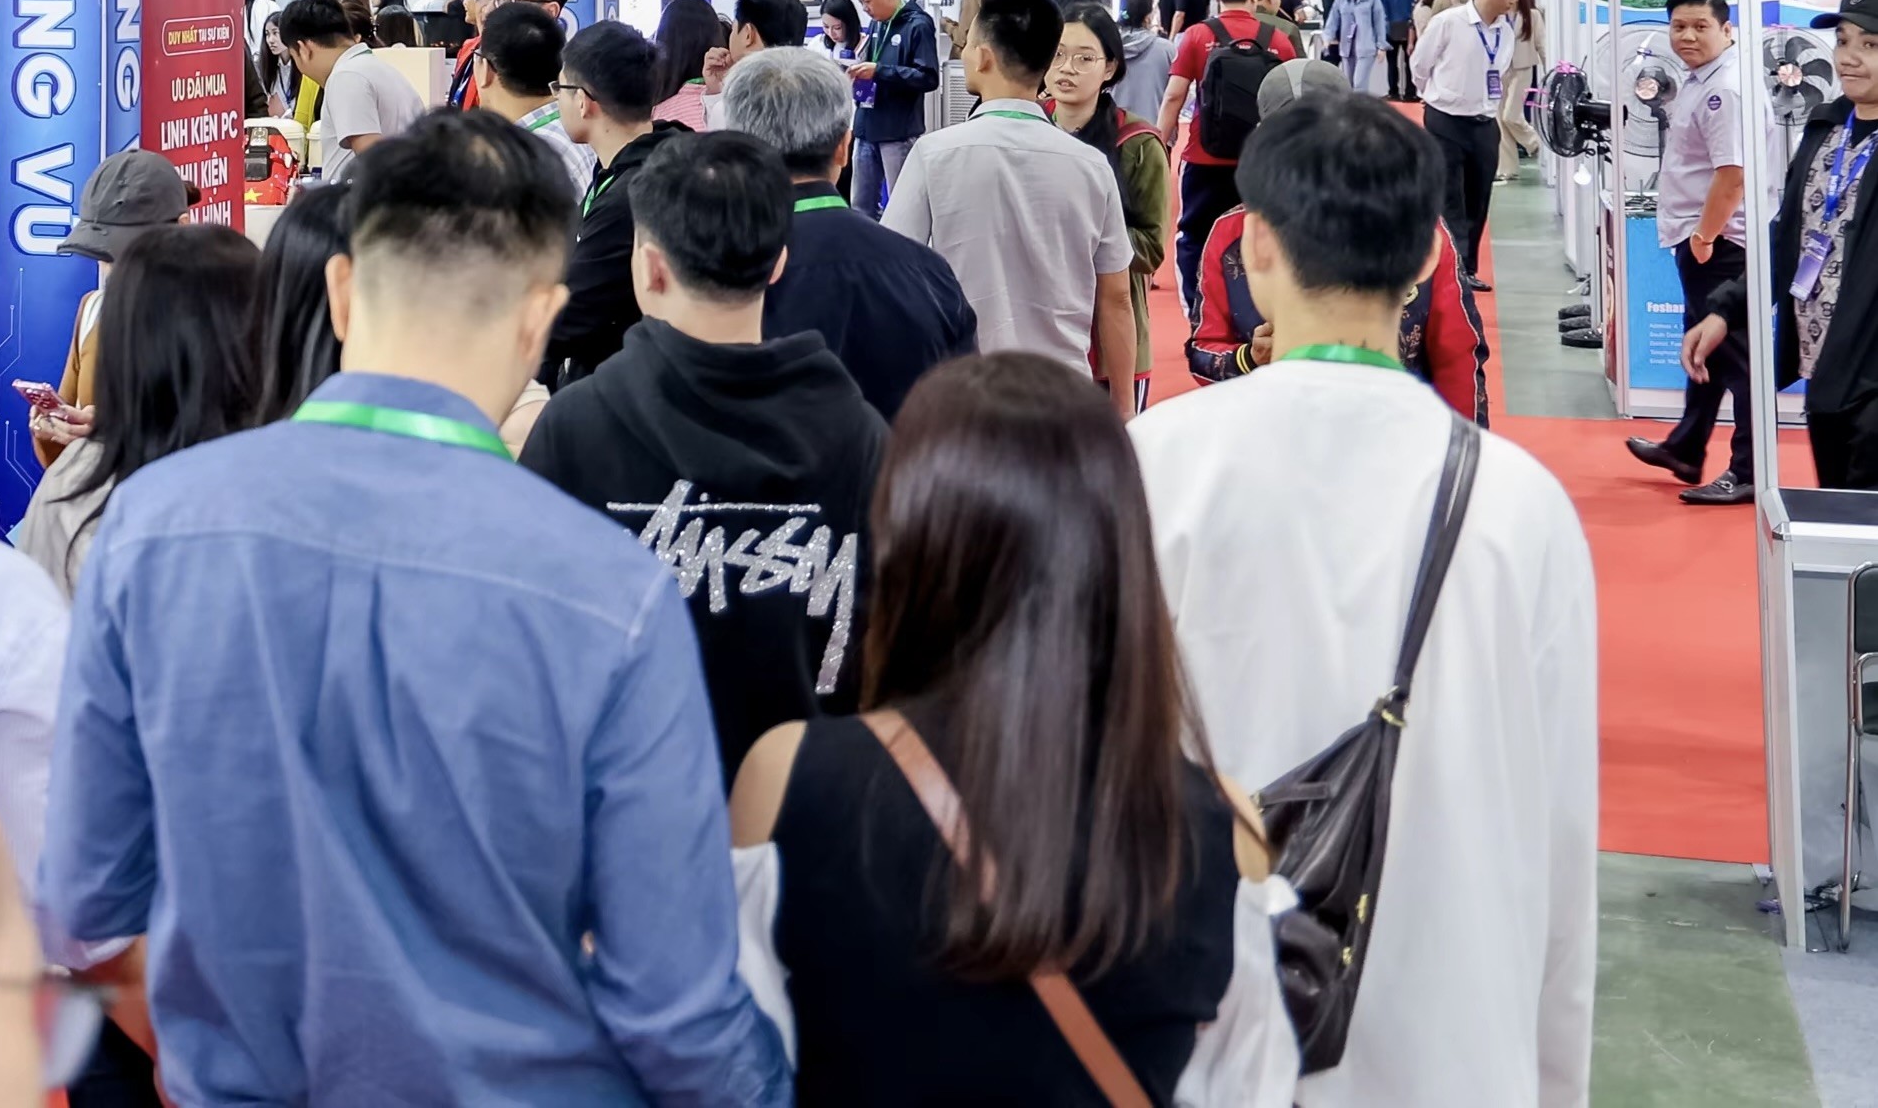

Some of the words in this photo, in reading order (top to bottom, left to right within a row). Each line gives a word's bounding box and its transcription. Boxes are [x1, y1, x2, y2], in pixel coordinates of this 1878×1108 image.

[168, 29, 182, 45] DUY
[182, 24, 197, 43] NHẤT
[171, 76, 185, 102] ƯU
[186, 70, 205, 99] ĐÃI
[205, 73, 227, 97] MUA
[161, 118, 188, 151] LINH
[190, 108, 218, 152] KIỆN
[221, 110, 239, 140] PC
[201, 150, 228, 195] KIỆN
[202, 197, 231, 227] HÌNH
